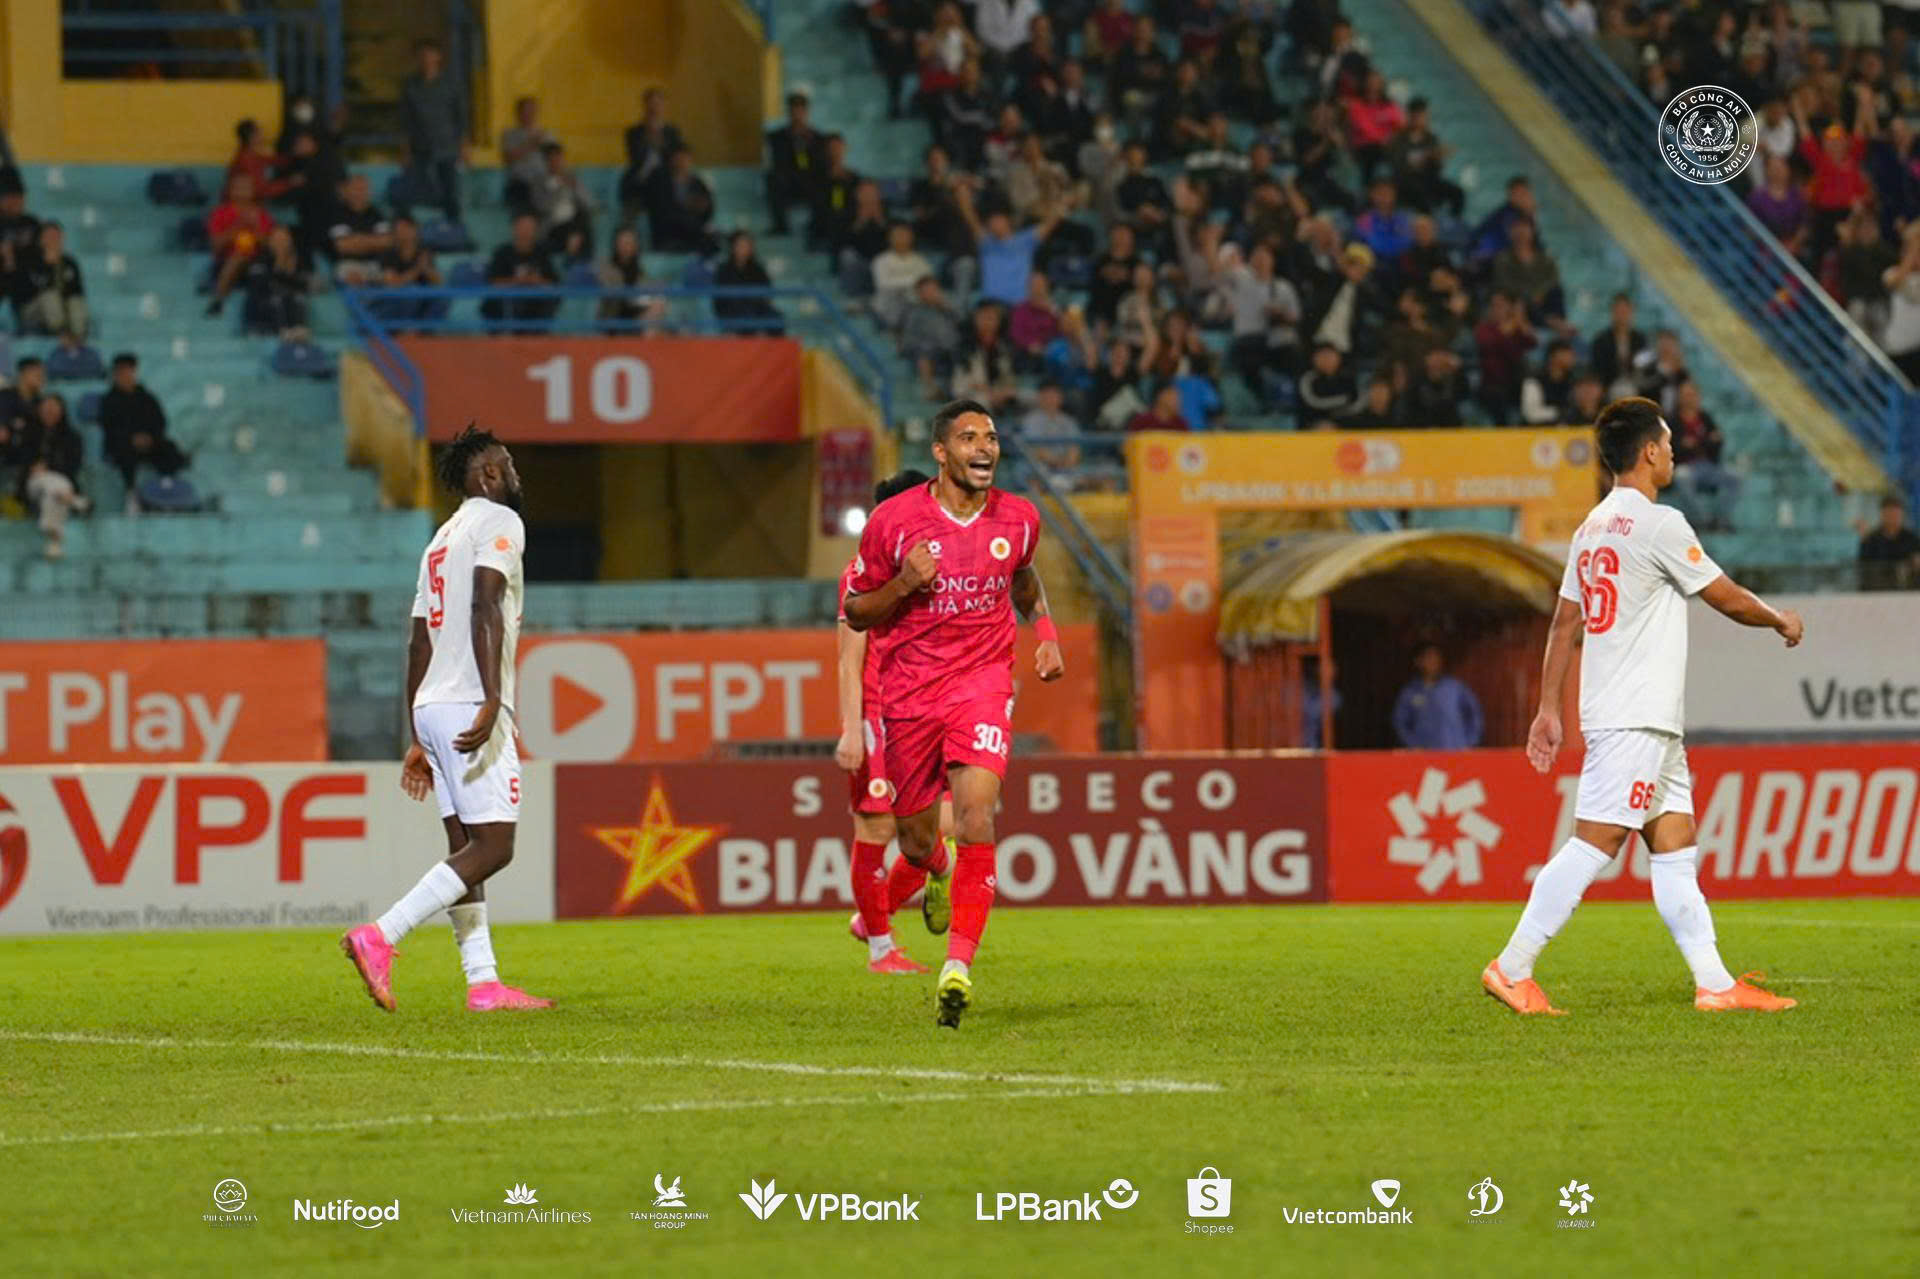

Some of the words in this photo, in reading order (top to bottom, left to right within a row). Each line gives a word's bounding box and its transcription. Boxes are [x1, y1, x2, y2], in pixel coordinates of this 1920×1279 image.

[526, 354, 652, 424] 10
[427, 545, 448, 628] 5
[928, 595, 960, 615] HÀ
[983, 576, 1007, 592] AN
[1577, 545, 1619, 634] 66
[50, 671, 243, 762] Play
[655, 661, 821, 742] FPT
[972, 722, 1003, 754] 30
[509, 777, 521, 804] 5
[1629, 780, 1655, 811] 66
[50, 773, 367, 886] VPF
[717, 837, 856, 906] BIA
[1068, 817, 1312, 900] VÀNG
[46, 905, 139, 929] Vietnam
[144, 902, 272, 927] Professional
[279, 901, 371, 925] Football
